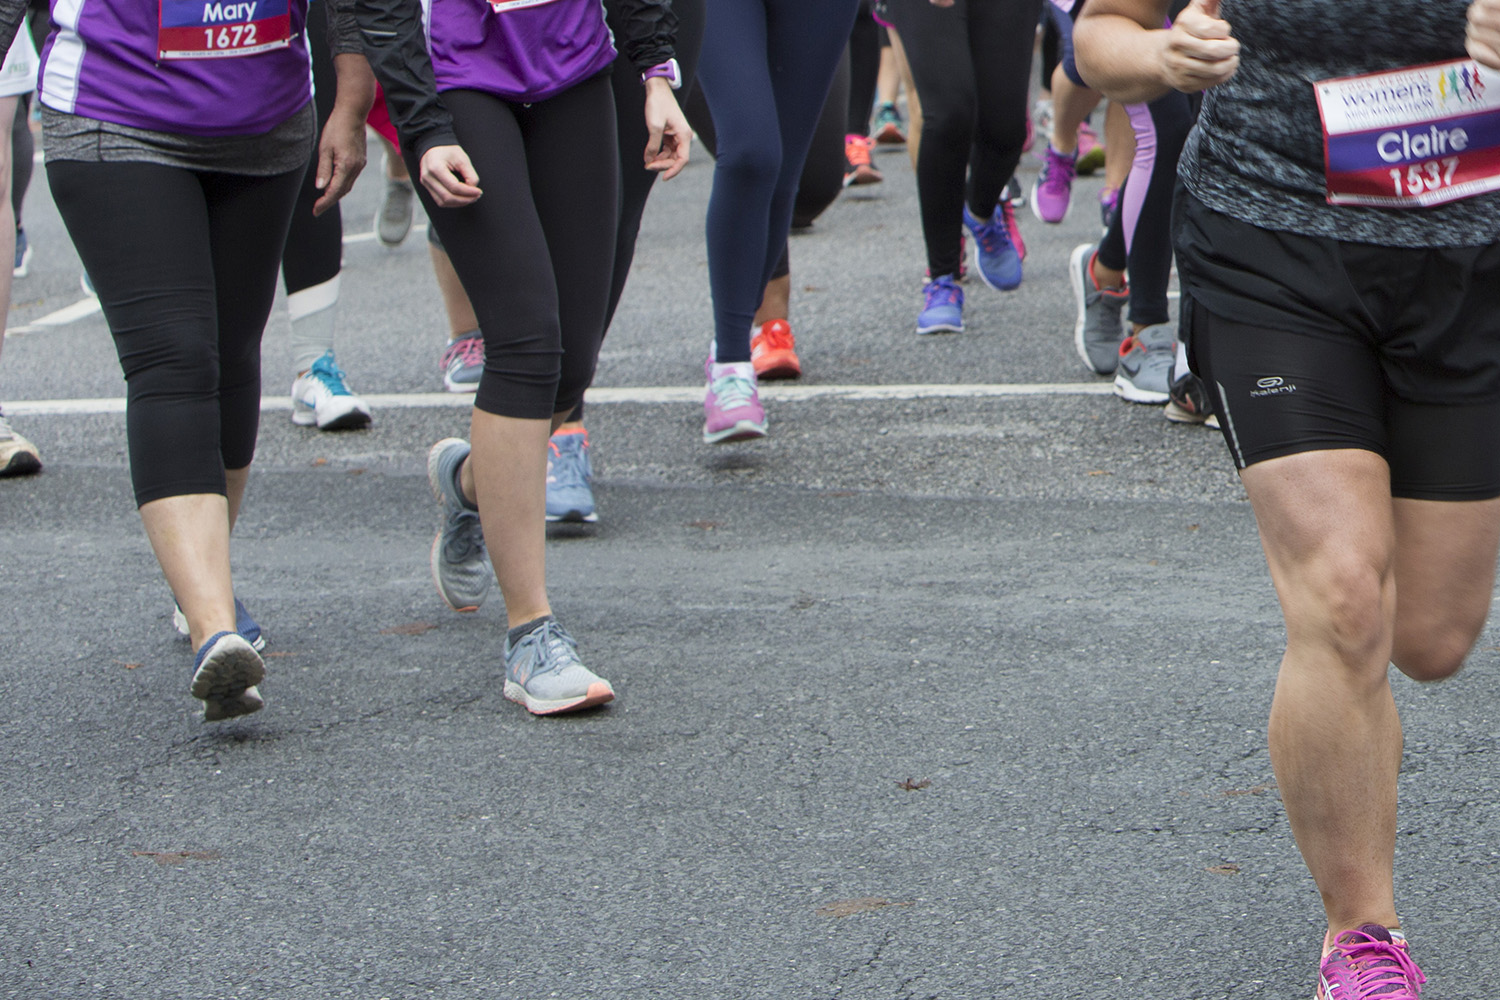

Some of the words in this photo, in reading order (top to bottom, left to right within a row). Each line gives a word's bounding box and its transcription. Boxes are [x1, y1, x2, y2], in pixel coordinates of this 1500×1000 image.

[202, 1, 257, 22] Mary
[204, 23, 257, 49] 1672
[1376, 125, 1470, 164] Claire
[1389, 156, 1460, 198] 1537
